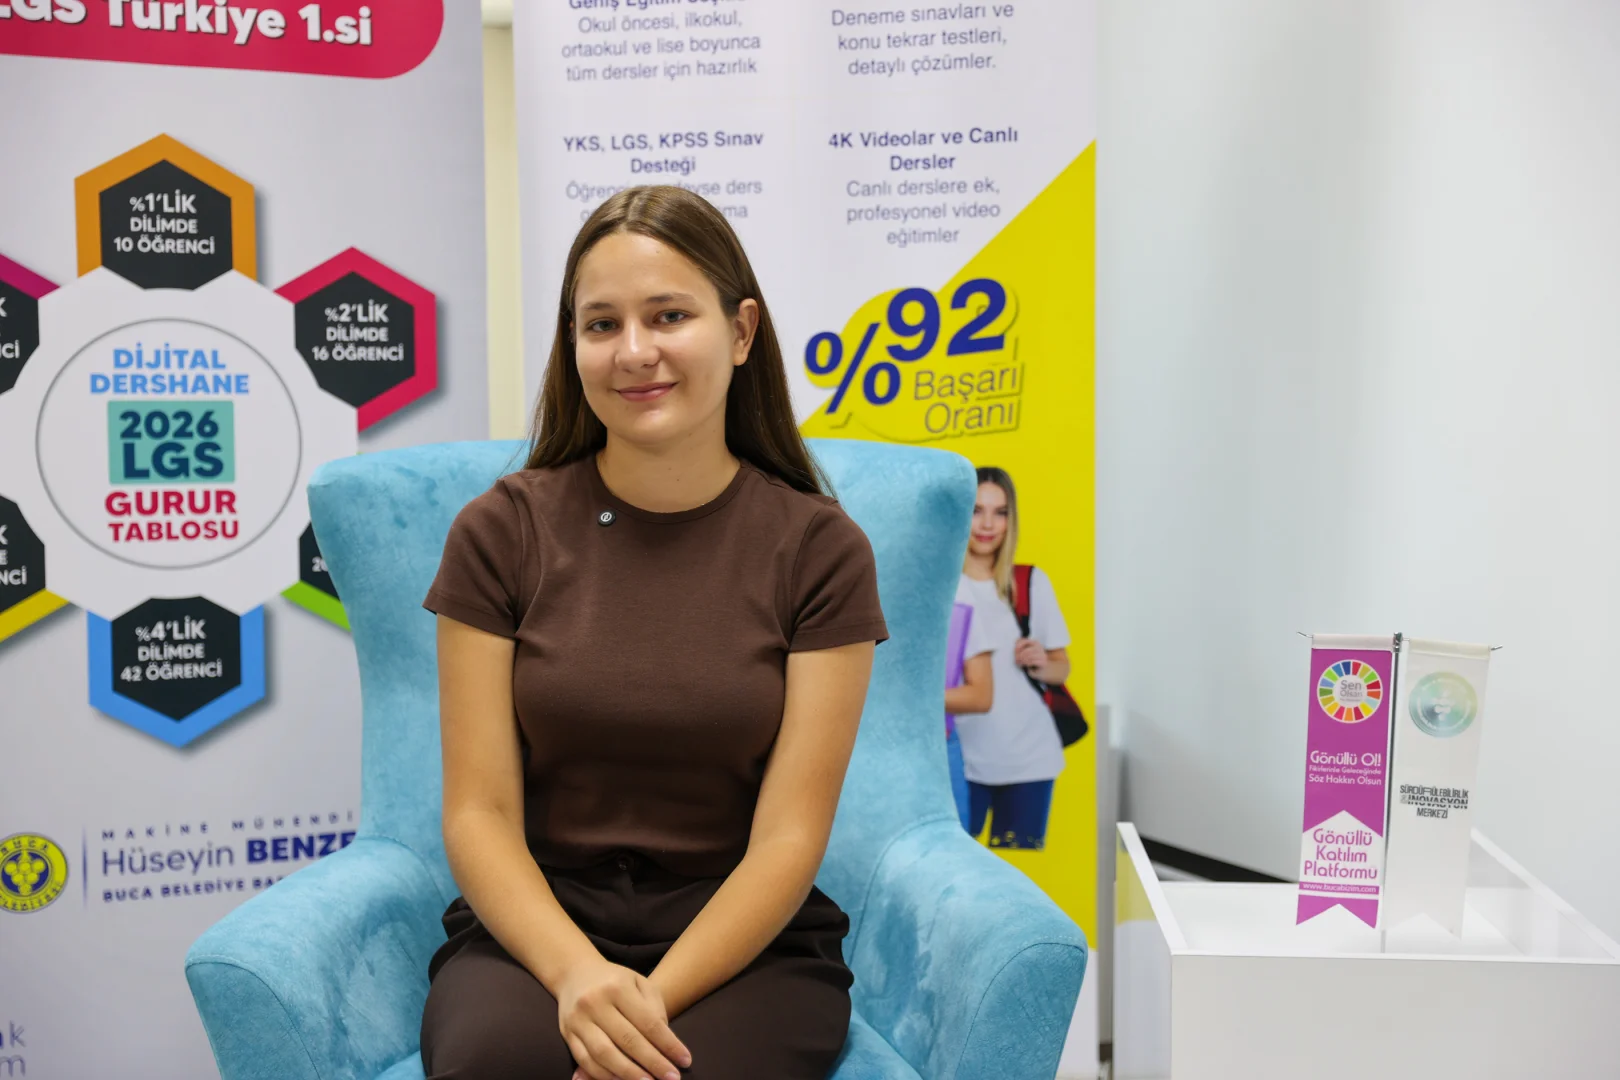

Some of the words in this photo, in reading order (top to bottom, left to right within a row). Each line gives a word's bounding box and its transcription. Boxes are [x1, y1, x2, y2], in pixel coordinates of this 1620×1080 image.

[298, 3, 372, 46] 1.si
[578, 16, 616, 34] Okul
[621, 12, 679, 31] öncesi,
[685, 10, 743, 28] ilkokul,
[831, 9, 905, 26] Deneme
[911, 3, 986, 23] sınavları
[992, 4, 1014, 18] ve
[561, 40, 628, 58] ortaokul
[632, 43, 652, 55] ve
[656, 38, 684, 53] lise
[689, 36, 761, 55] boyunca
[838, 34, 881, 51] konu
[887, 31, 936, 48] tekrar
[941, 26, 1007, 46] testleri,
[566, 66, 597, 82] tüm
[602, 63, 659, 81] dersler
[663, 60, 691, 80] için
[696, 58, 757, 75] hazırlık
[848, 58, 905, 78] detaylı
[911, 53, 996, 76] çözümler.
[563, 135, 605, 152] YKS,
[611, 134, 653, 151] LGS,
[659, 131, 708, 149] KPSS
[714, 130, 764, 147] Sınav
[828, 132, 854, 149] 4K
[859, 130, 935, 147] Videolar
[941, 131, 963, 144] ve
[969, 126, 1019, 144] Canlı
[630, 156, 696, 176] Desteği
[890, 153, 956, 171] Dersler
[725, 179, 763, 195] ders
[846, 179, 893, 198] Canlı
[897, 177, 968, 196] derslere
[973, 176, 1000, 195] ek,
[130, 213, 198, 234] DİLİMDE
[846, 202, 947, 225] profesyonel
[952, 201, 1001, 219] video
[113, 236, 134, 253] 10
[137, 234, 216, 255] ÖĞRENCİ
[886, 227, 960, 248] eğitimler
[326, 323, 389, 342] DİLİMDE
[113, 342, 227, 370] DİJİTAL
[311, 345, 329, 361] 16
[331, 342, 405, 362] ÖĞRENCİ
[804, 277, 1007, 415] %92
[89, 373, 250, 394] DERSHANE
[914, 366, 1017, 404] Başarı
[119, 409, 220, 440] 2026
[924, 401, 1013, 434] Oranı
[122, 440, 225, 480] LGS
[105, 489, 238, 517] GURUR
[108, 519, 239, 542] TABLOSU
[137, 641, 205, 662] DİLİMDE
[120, 665, 143, 682] 42
[145, 658, 223, 681] ÖĞRENCİ
[1340, 679, 1362, 690] Sen
[1340, 689, 1363, 698] Olsan
[1310, 750, 1358, 766] Gönüllü
[1308, 773, 1325, 784] Söz
[1325, 774, 1356, 785] Hakkın
[1357, 775, 1382, 786] Olsun
[102, 821, 209, 842] MAKİNE
[231, 810, 353, 831] MÜHENDİ
[1313, 827, 1373, 846] Gönüllü
[102, 841, 235, 877] Hüseyin
[246, 830, 357, 865] BENZE
[1315, 844, 1367, 863] Katılım
[1304, 860, 1378, 879] Platformu
[103, 887, 153, 903] BUCA
[161, 877, 244, 899] BELEDİYE
